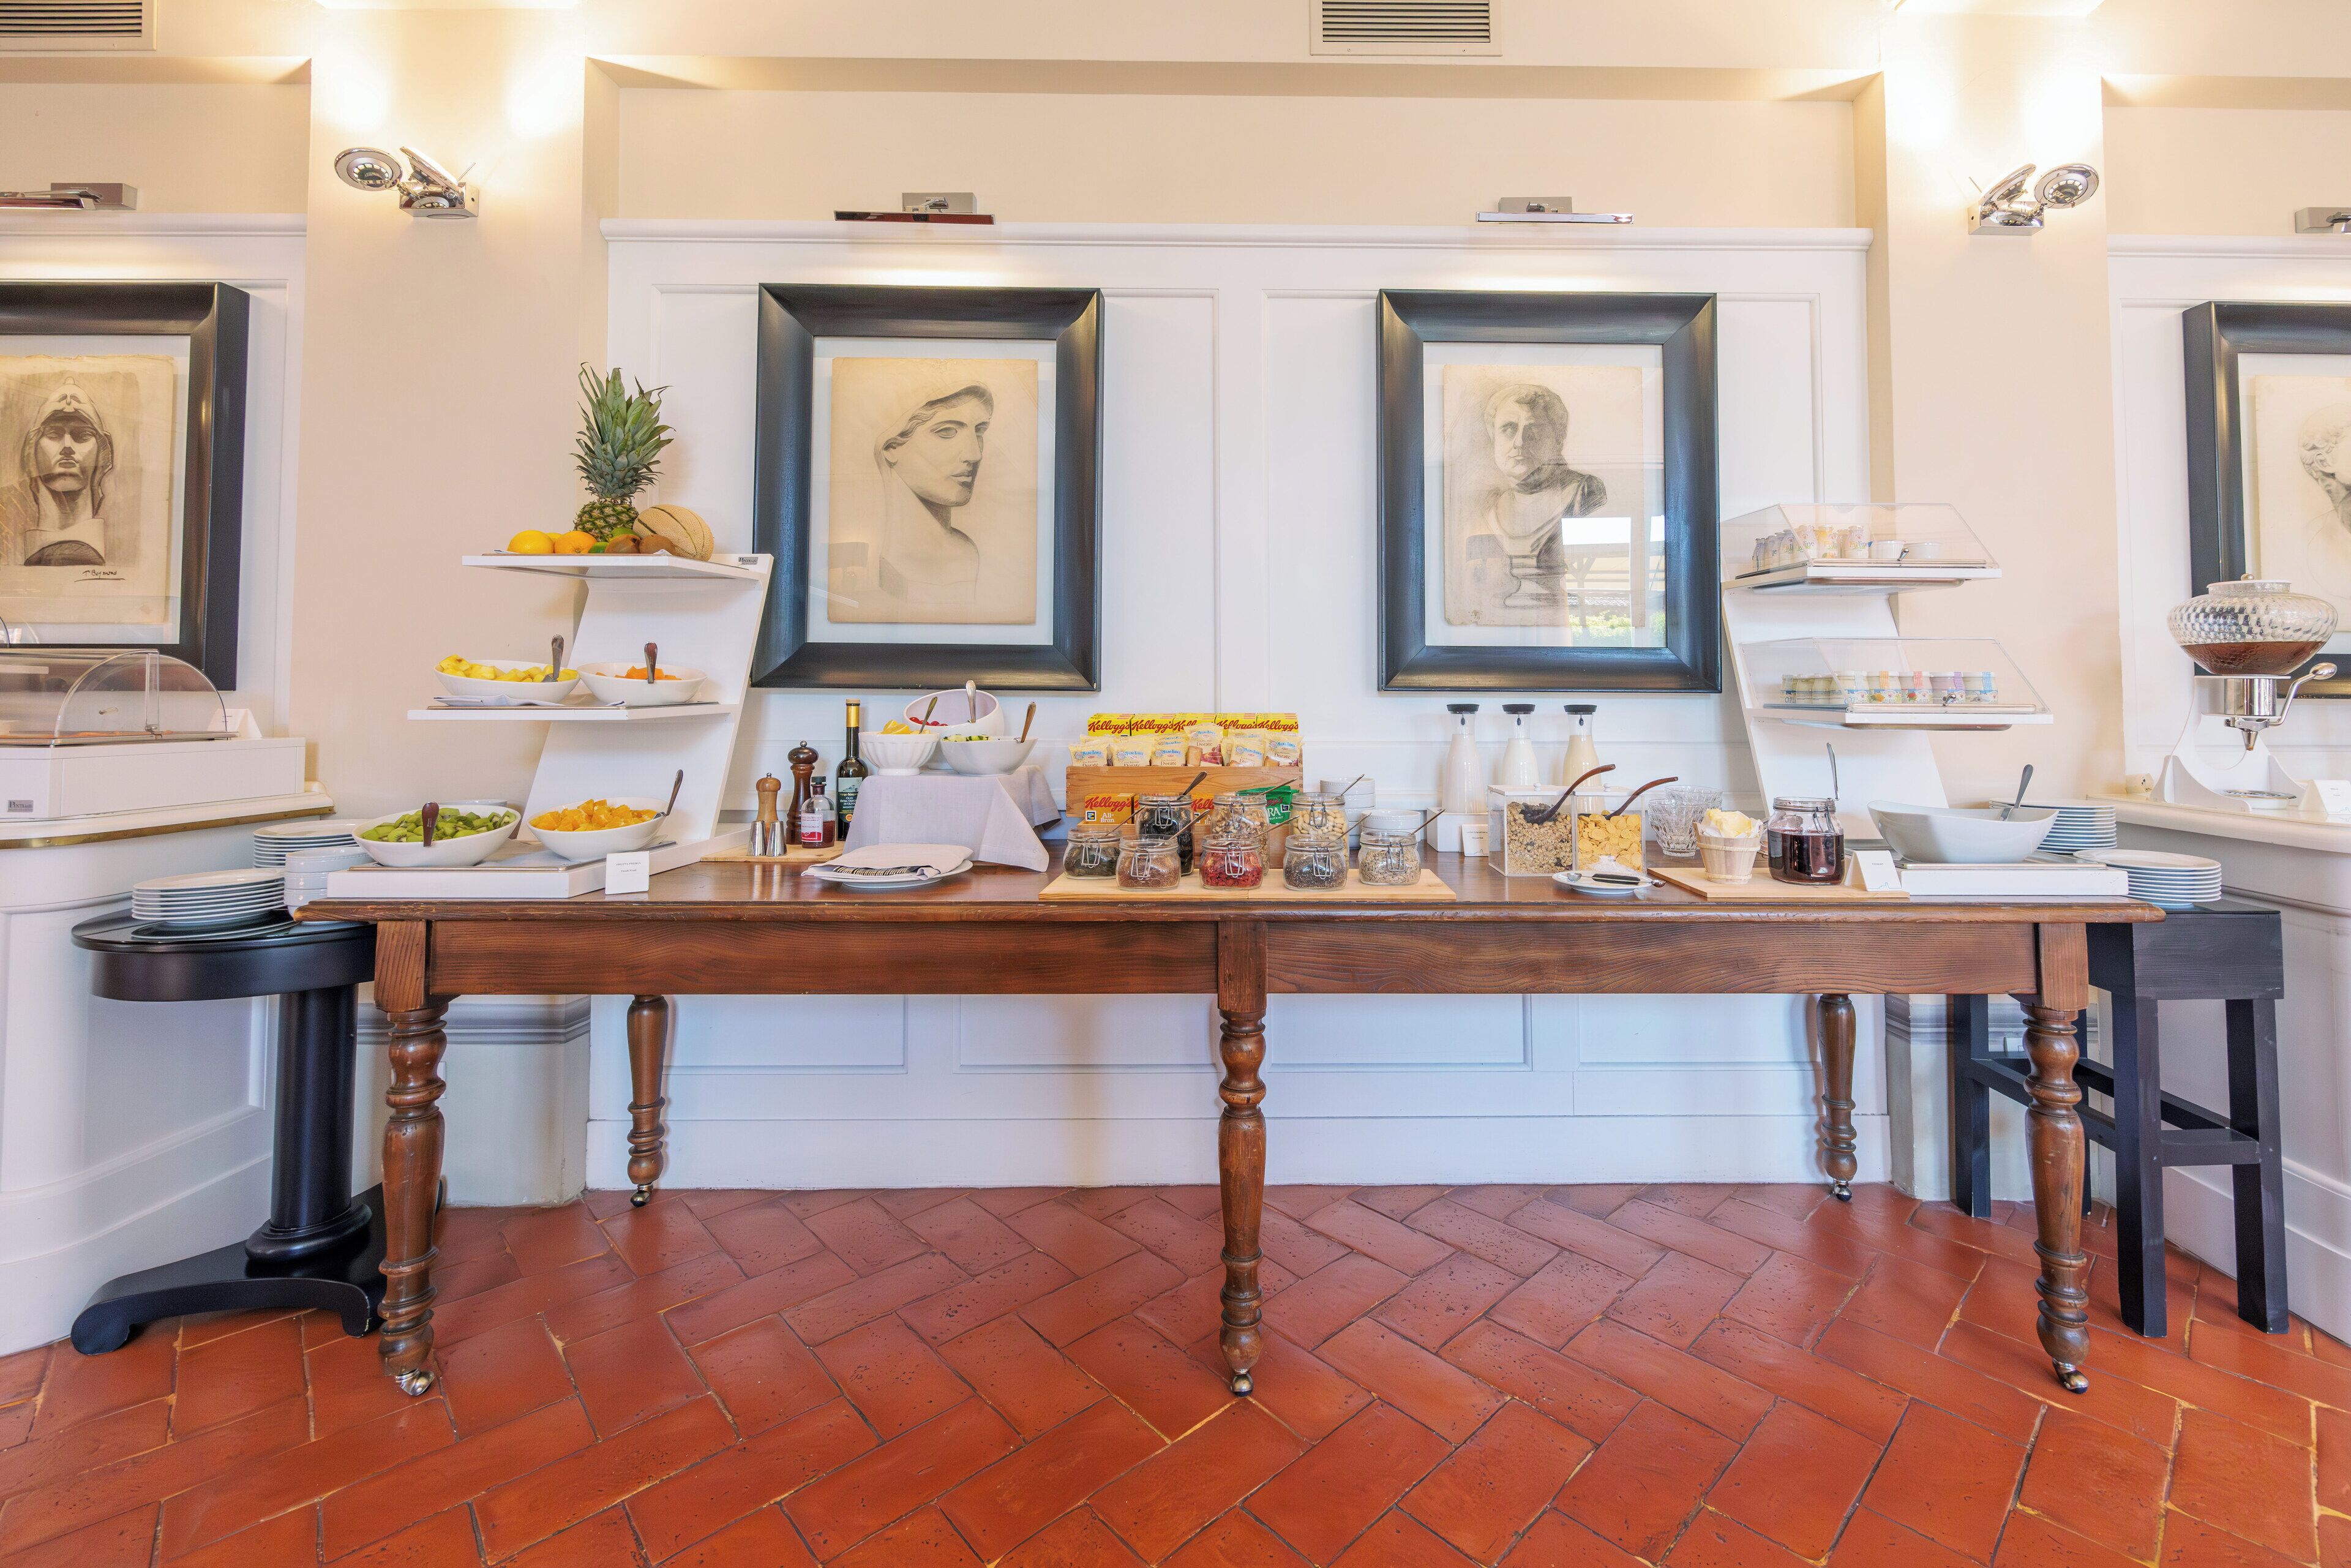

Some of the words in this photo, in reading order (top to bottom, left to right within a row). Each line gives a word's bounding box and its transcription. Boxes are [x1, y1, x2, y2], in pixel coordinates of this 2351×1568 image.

[1088, 720, 1130, 733] Kellogg's
[1131, 719, 1173, 733] Kellogg's
[1173, 720, 1198, 732] Kell
[1257, 719, 1299, 732] Kellogg's
[1084, 796, 1131, 812] Kellogg's
[1191, 798, 1214, 811] Kell
